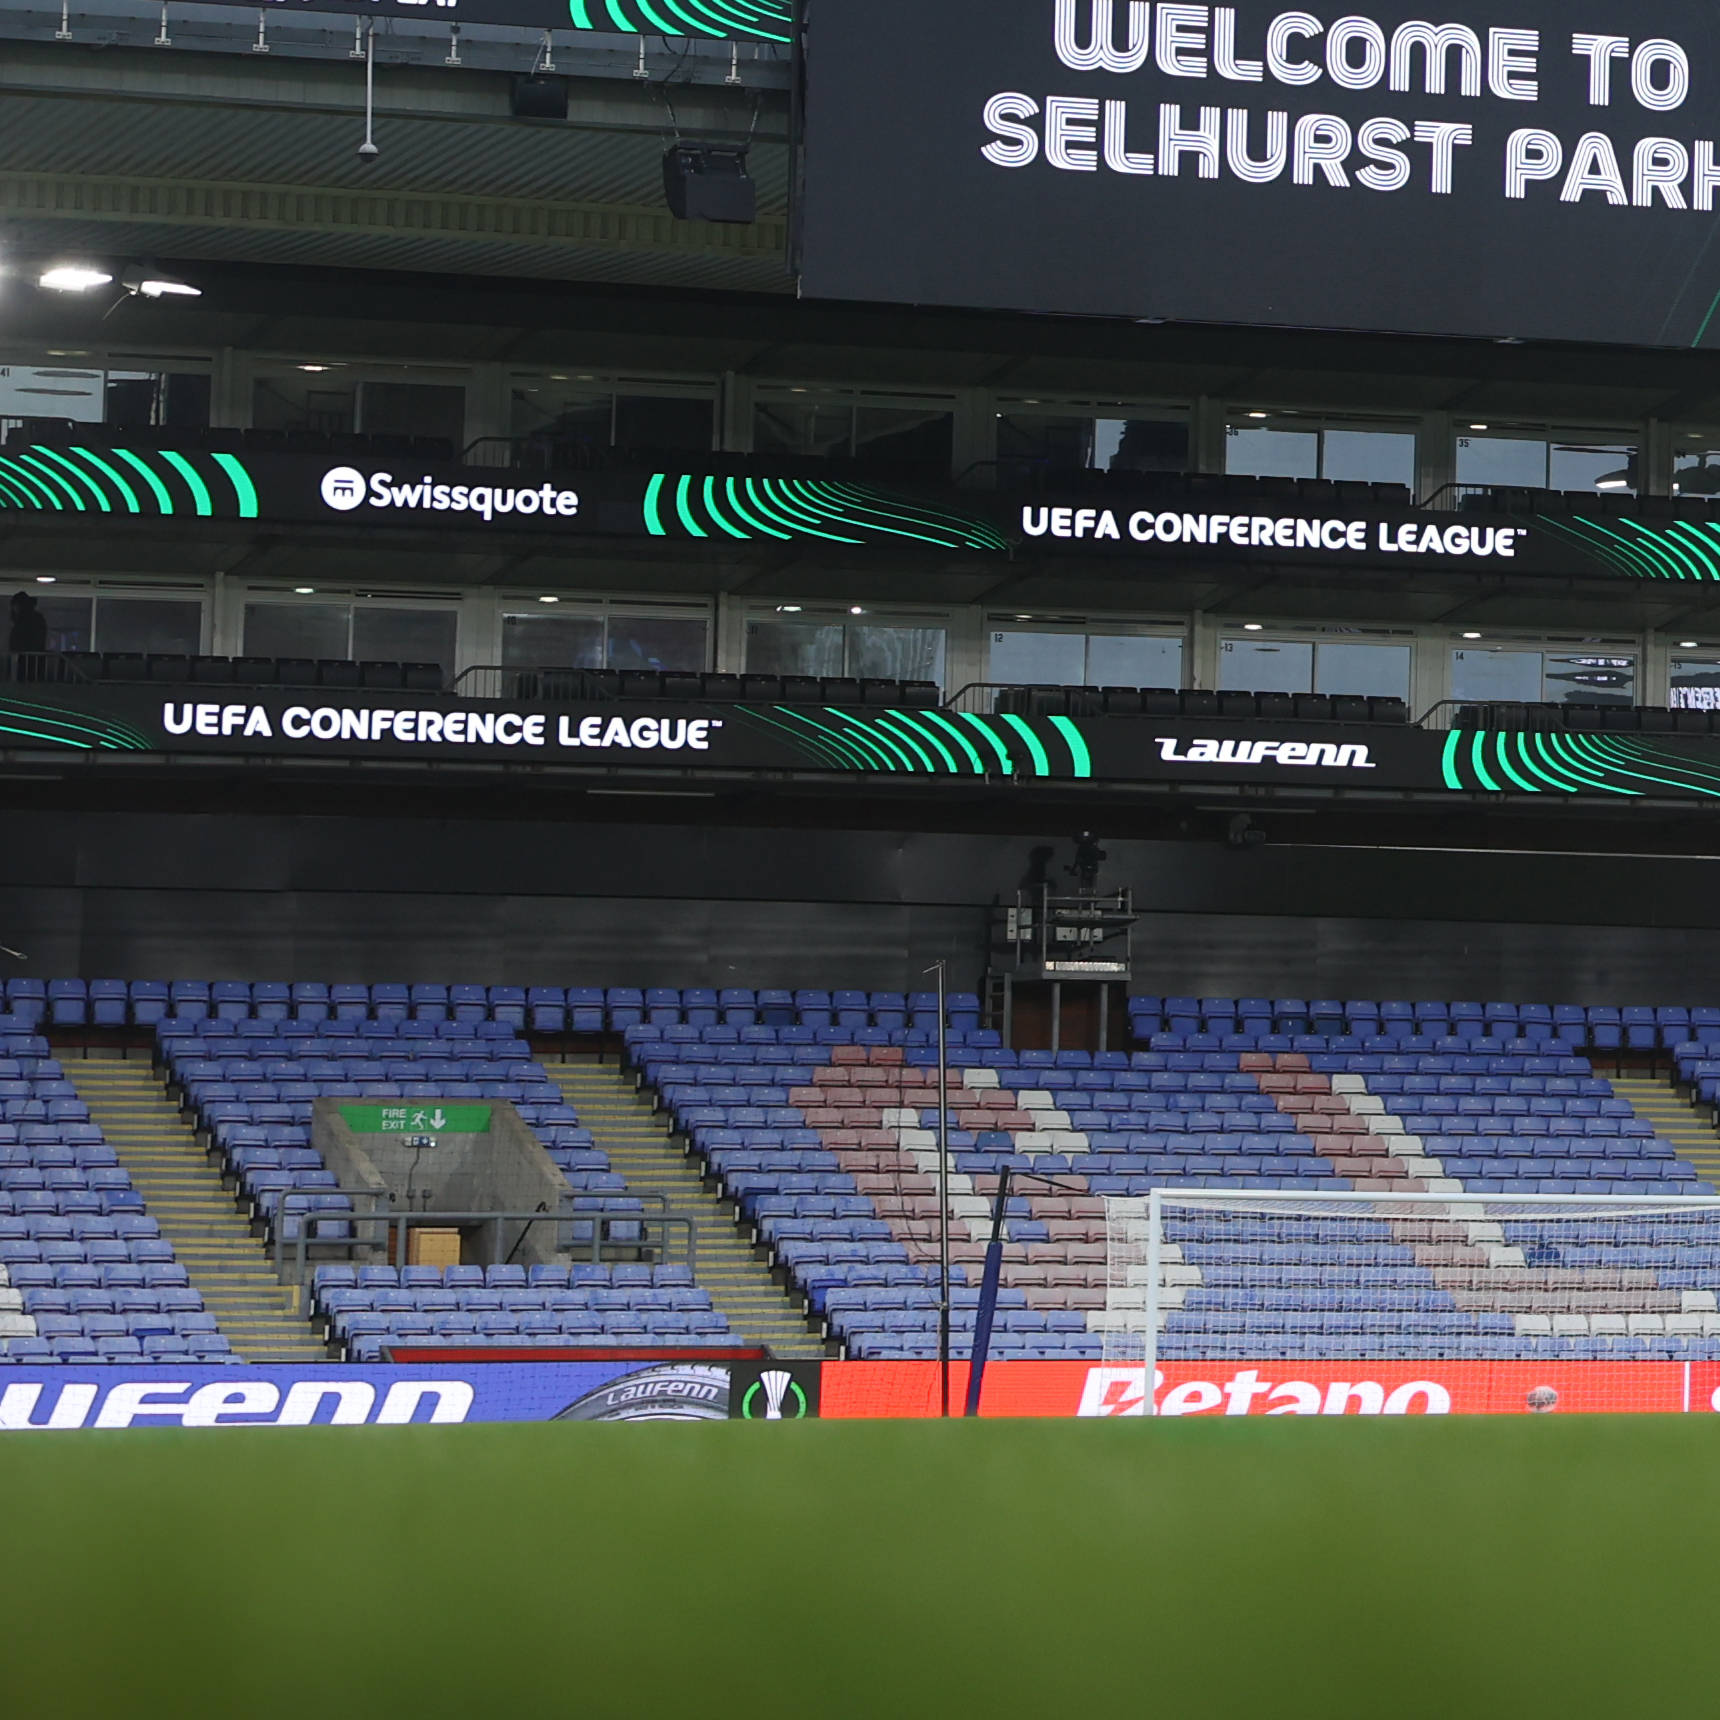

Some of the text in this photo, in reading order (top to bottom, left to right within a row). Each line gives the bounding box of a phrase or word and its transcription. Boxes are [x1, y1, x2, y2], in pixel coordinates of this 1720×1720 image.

[1572, 33, 1689, 111] TO
[980, 91, 1474, 195] SELHURST
[369, 473, 578, 520] Swissquote
[1023, 507, 1120, 539] UEFA
[1129, 511, 1366, 550] CONFERENCE
[164, 703, 272, 736] UEFA
[282, 707, 545, 745] CONFERENCE
[382, 1108, 407, 1119] FIRE
[382, 1120, 406, 1130] EXIT
[1077, 1367, 1451, 1417] Betano
